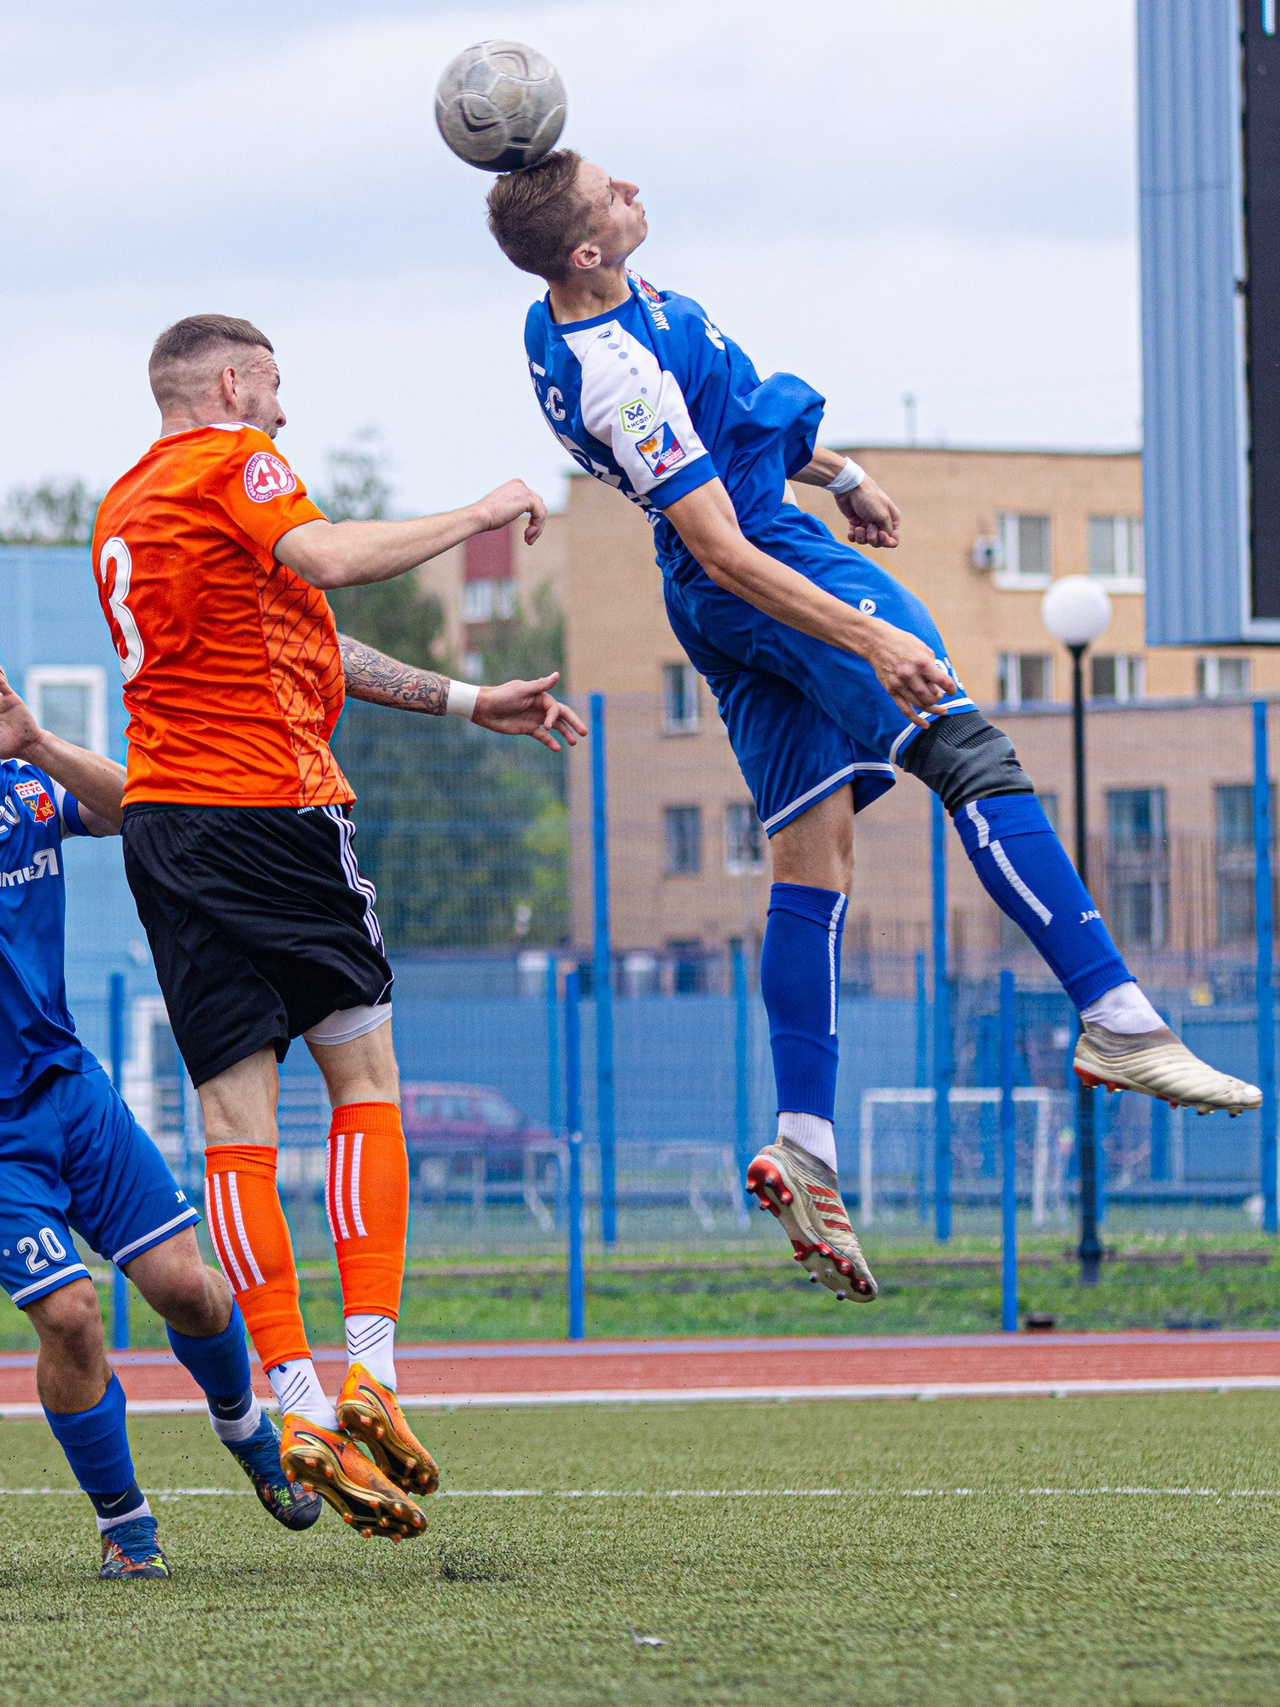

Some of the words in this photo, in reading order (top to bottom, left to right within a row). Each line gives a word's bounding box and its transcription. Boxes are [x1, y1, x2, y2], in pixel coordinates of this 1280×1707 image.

[651, 310, 671, 331] JAKO
[99, 536, 145, 682] 3
[16, 1226, 67, 1274] 20
